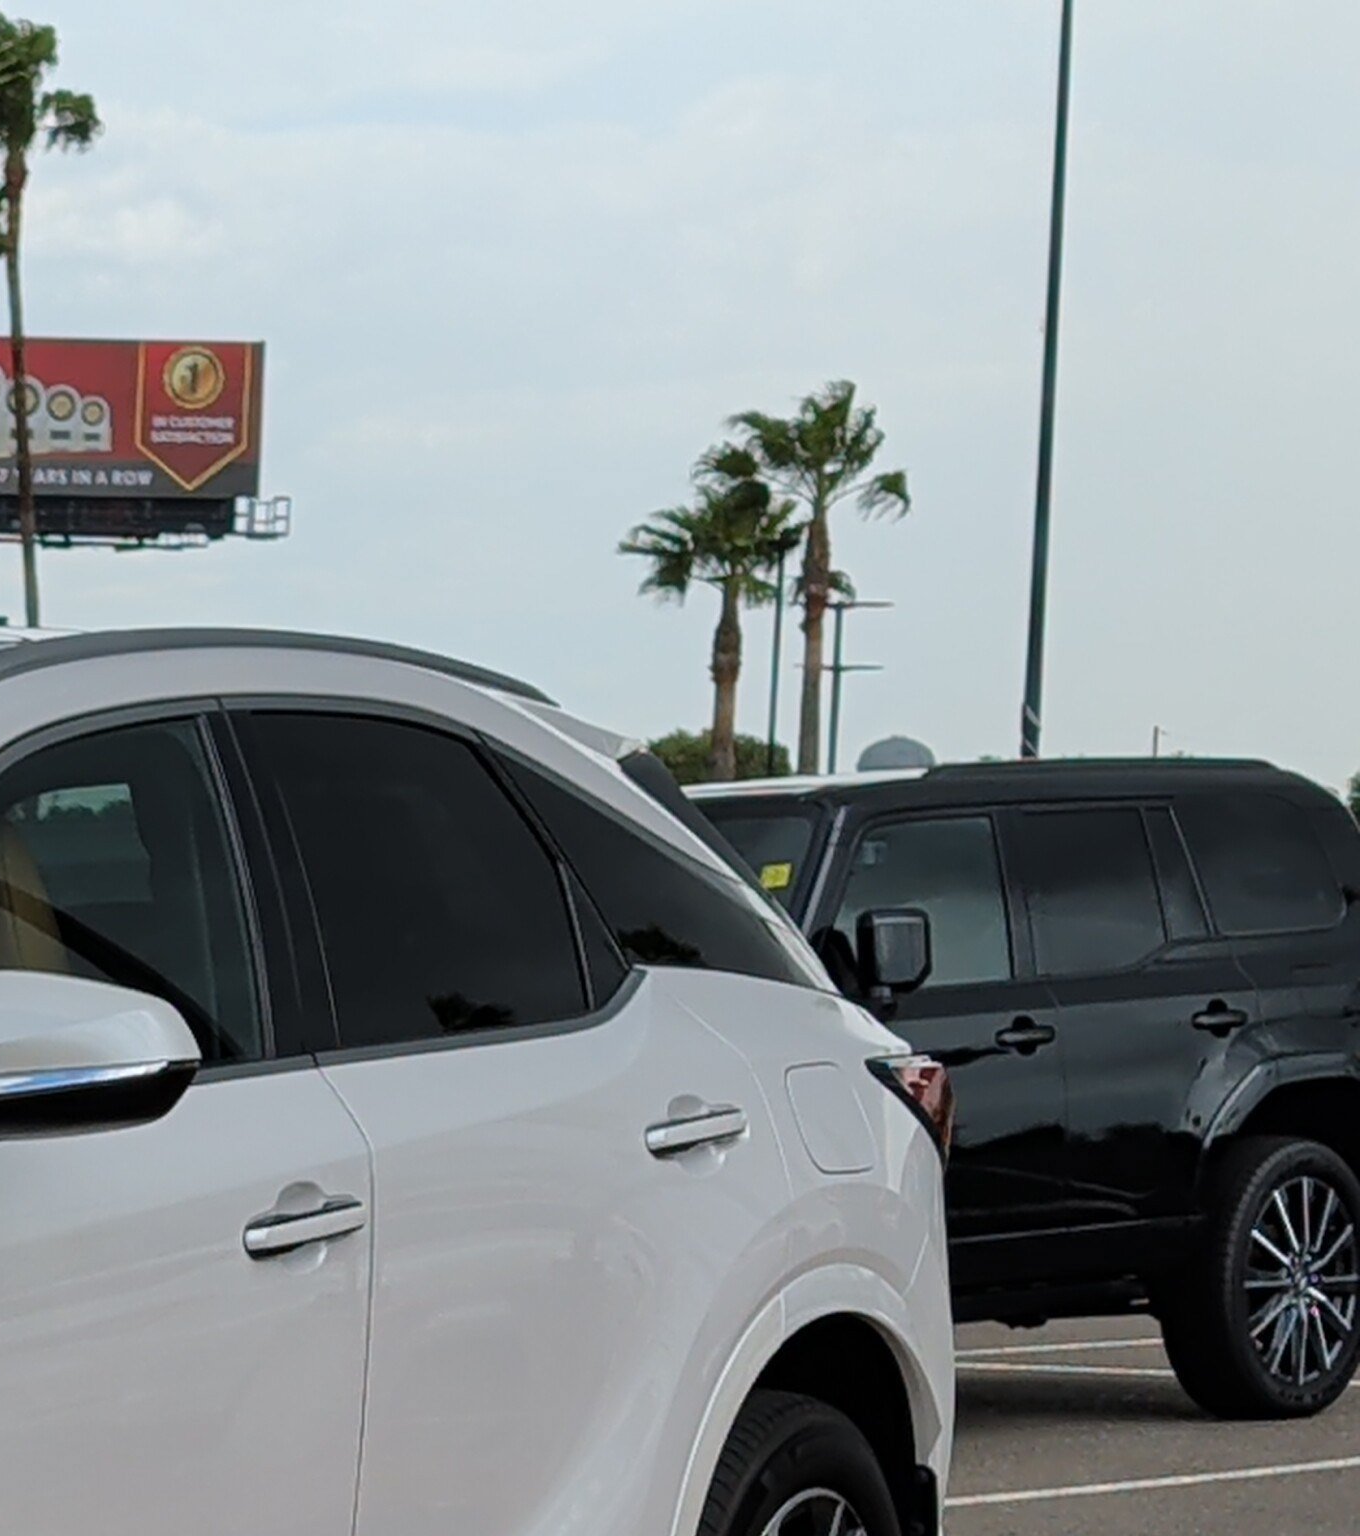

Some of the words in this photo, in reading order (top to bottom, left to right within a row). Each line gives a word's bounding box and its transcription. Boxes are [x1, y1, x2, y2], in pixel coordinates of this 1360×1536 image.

[71, 469, 92, 485] IN
[94, 469, 108, 485] A
[111, 470, 153, 486] ROW
